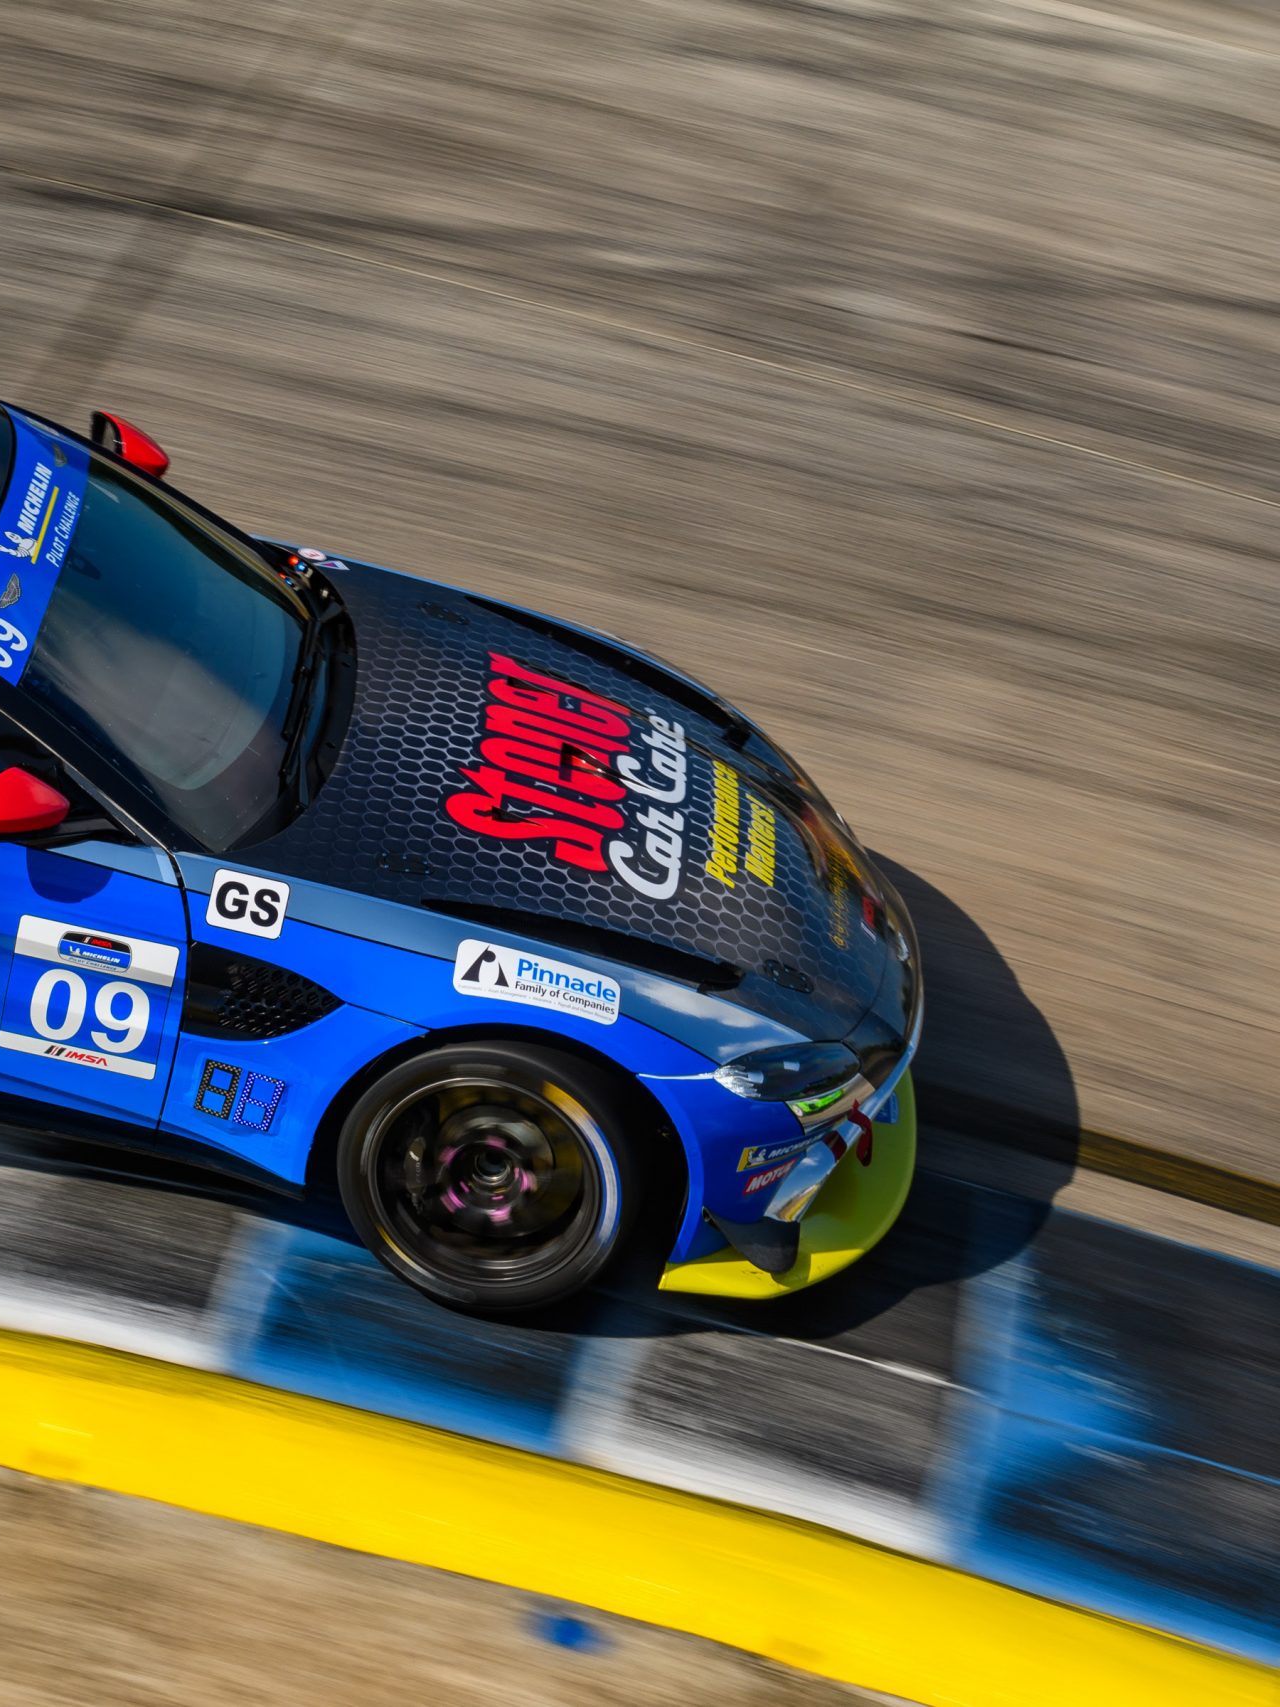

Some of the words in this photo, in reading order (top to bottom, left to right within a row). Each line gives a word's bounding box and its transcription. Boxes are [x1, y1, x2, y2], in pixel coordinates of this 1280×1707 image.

[17, 461, 53, 535] MICHELIN
[54, 491, 80, 540] CHALLENGE
[45, 536, 67, 568] PILOT
[445, 651, 632, 872] Stoner
[705, 760, 740, 888] Performance
[744, 793, 776, 887] Matters!
[609, 811, 685, 900] Car
[215, 881, 282, 928] GS
[82, 950, 121, 964] MICHELIN
[516, 958, 617, 1003] Pinnacle
[29, 968, 150, 1054] 09
[515, 981, 547, 997] Family
[549, 989, 561, 999] of
[563, 991, 616, 1015] Companies
[64, 1051, 108, 1067] IMSA
